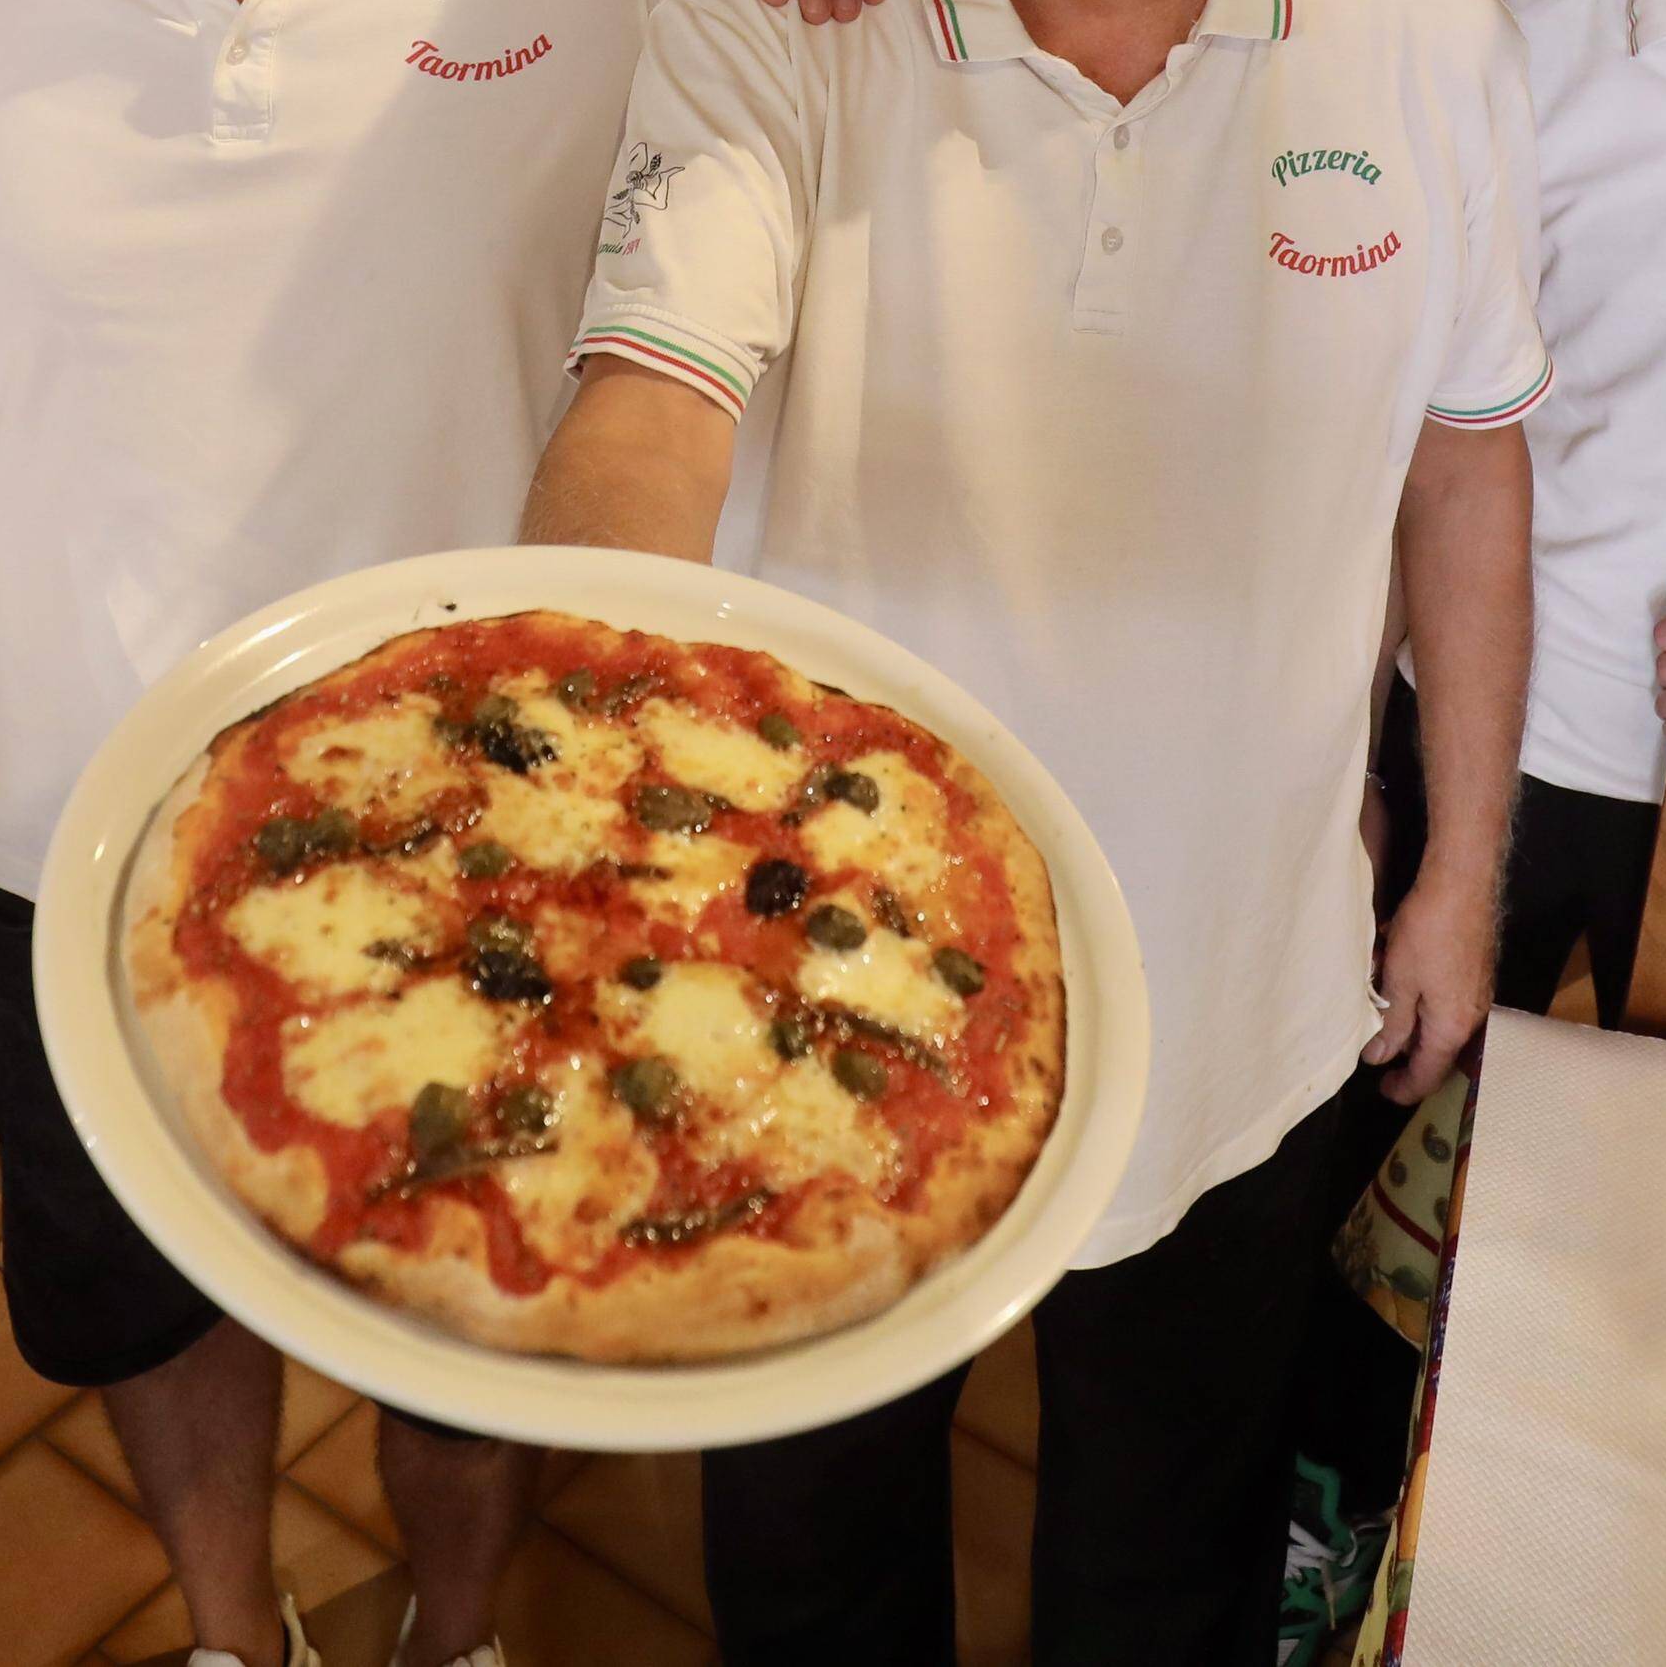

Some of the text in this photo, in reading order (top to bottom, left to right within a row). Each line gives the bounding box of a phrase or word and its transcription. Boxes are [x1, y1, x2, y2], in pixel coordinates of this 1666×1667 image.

[404, 33, 553, 82] Taormina
[1271, 149, 1382, 187] Pizzeria
[1268, 230, 1402, 277] Taormina
